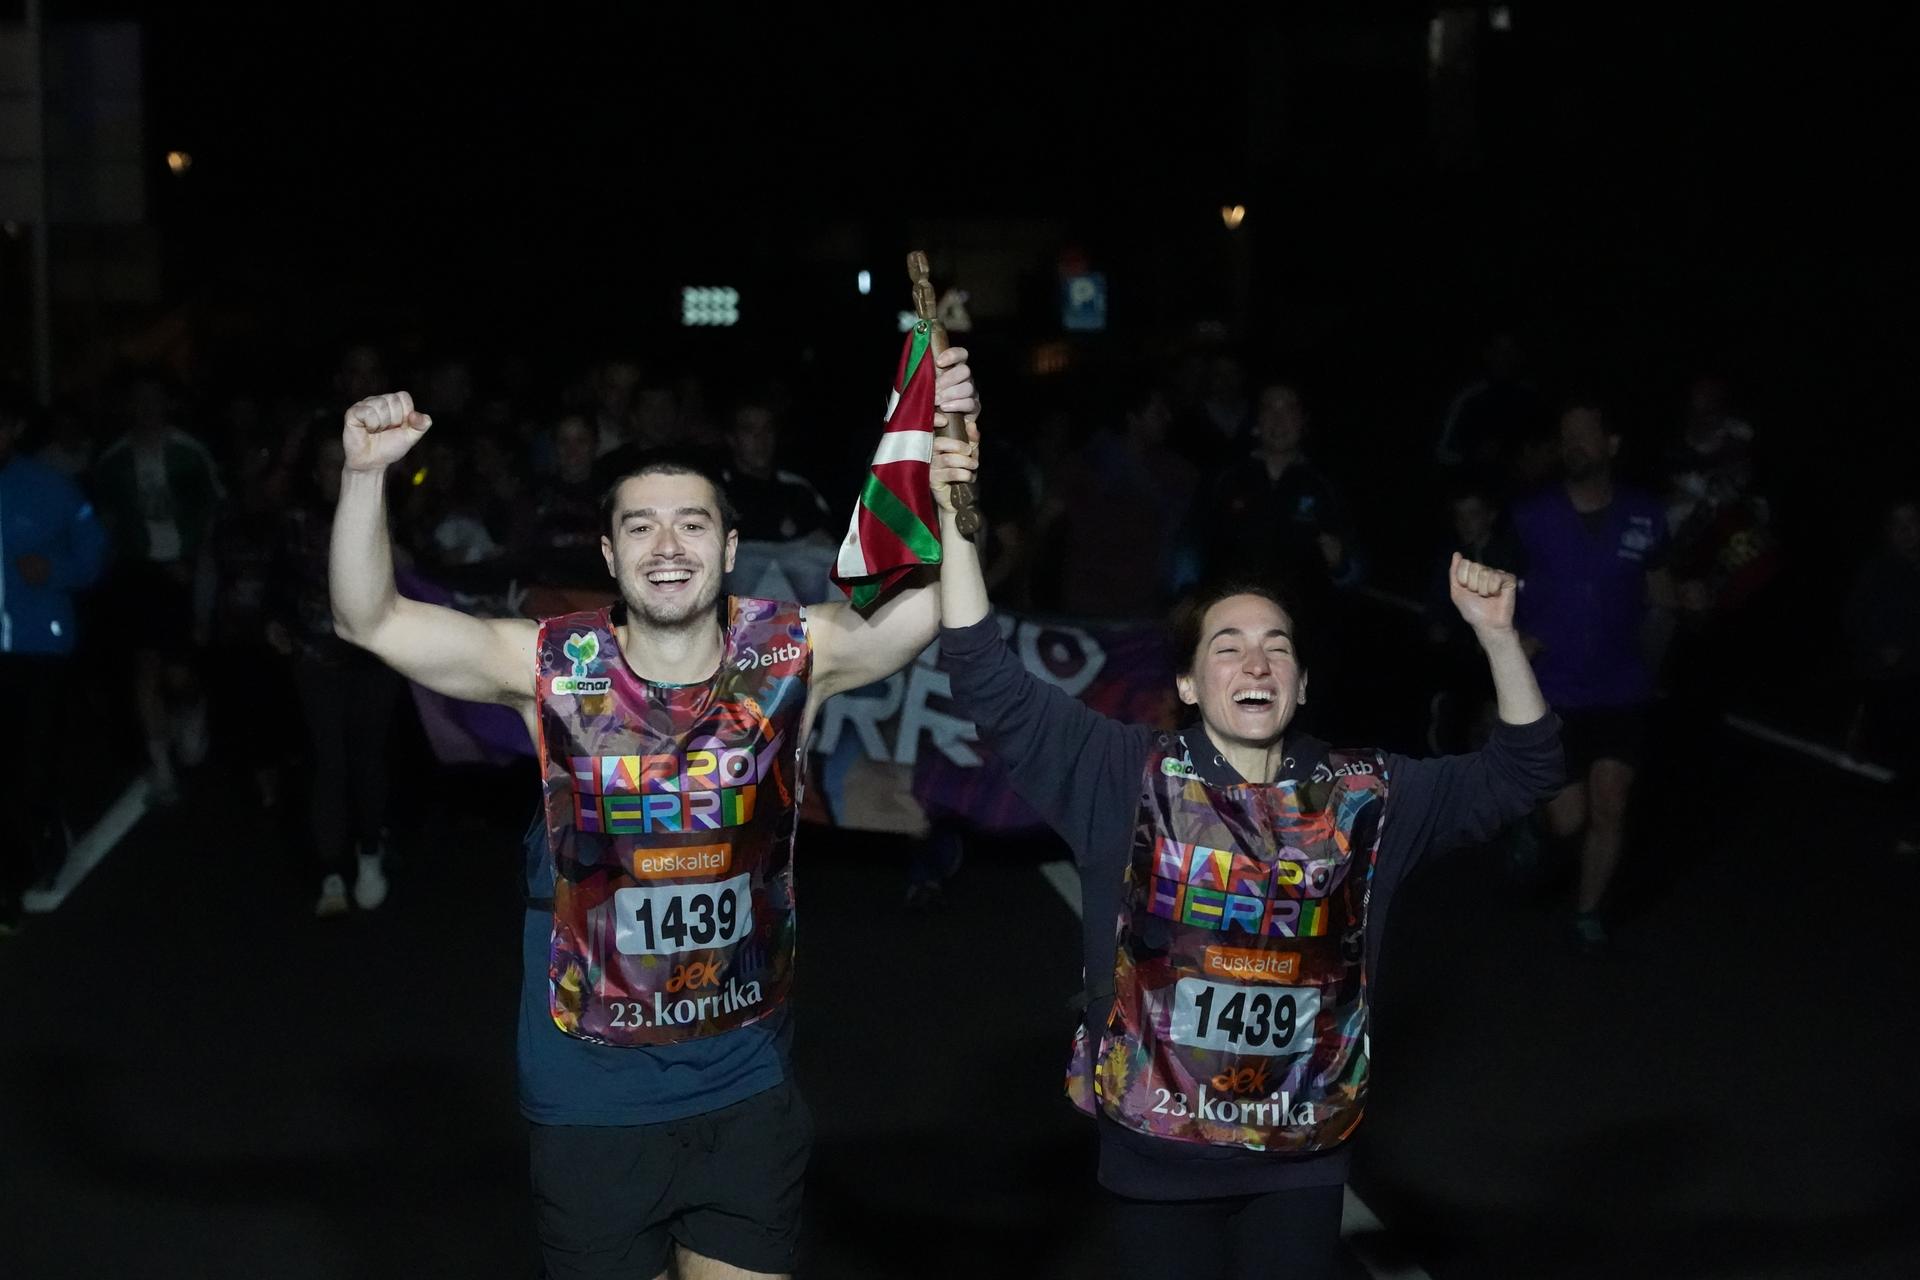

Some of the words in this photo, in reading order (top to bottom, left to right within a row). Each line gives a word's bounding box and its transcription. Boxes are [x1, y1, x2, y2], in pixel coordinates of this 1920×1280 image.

[760, 644, 801, 668] eitb
[567, 747, 757, 794] HARRO
[1334, 760, 1374, 778] eitb
[573, 785, 757, 834] HERRI
[640, 850, 725, 873] euskaltel
[635, 888, 737, 950] 1439
[1146, 873, 1329, 939] HERRI
[665, 951, 722, 993] aek
[1211, 953, 1293, 974] euskaltel
[1194, 985, 1298, 1048] 1439
[1211, 1058, 1271, 1094] aek
